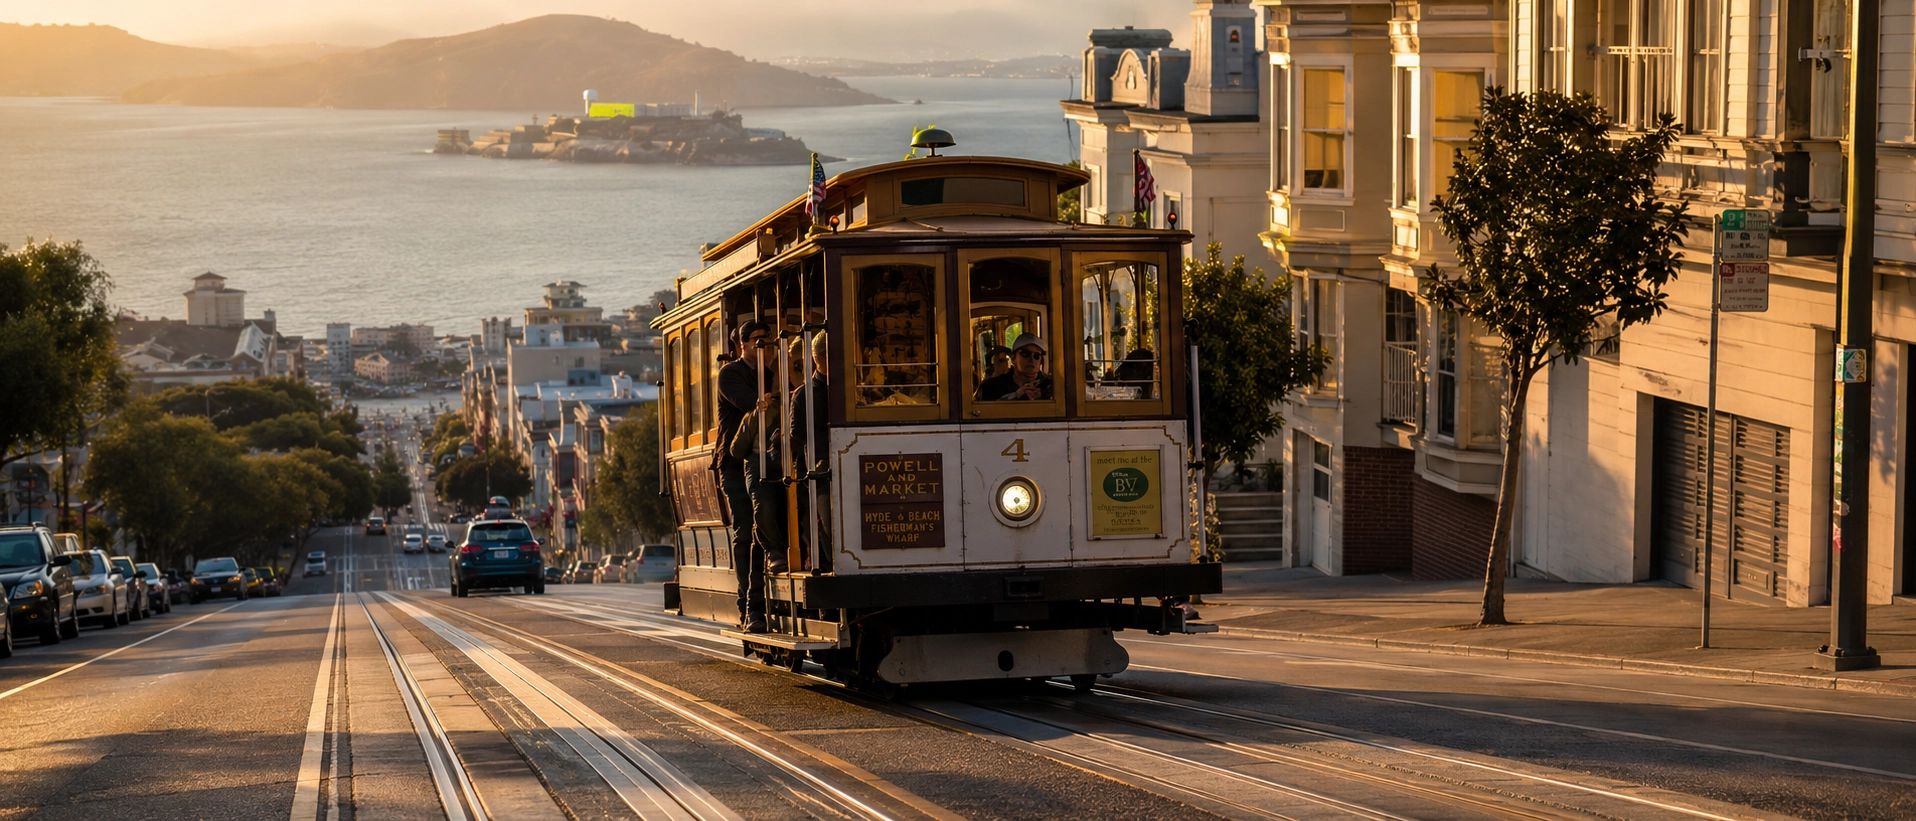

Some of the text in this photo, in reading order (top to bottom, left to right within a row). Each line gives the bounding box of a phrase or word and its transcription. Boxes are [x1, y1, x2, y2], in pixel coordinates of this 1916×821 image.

[1001, 439, 1030, 462] 4
[1140, 455, 1152, 463] the
[864, 460, 939, 473] POWELL
[887, 473, 916, 482] AND
[865, 482, 939, 495] MARKET
[1115, 477, 1138, 492] BV
[865, 512, 891, 522] HYDE
[908, 511, 940, 521] BEACH
[871, 523, 935, 533] FISHERMAN'S
[886, 533, 920, 543] WHARF
